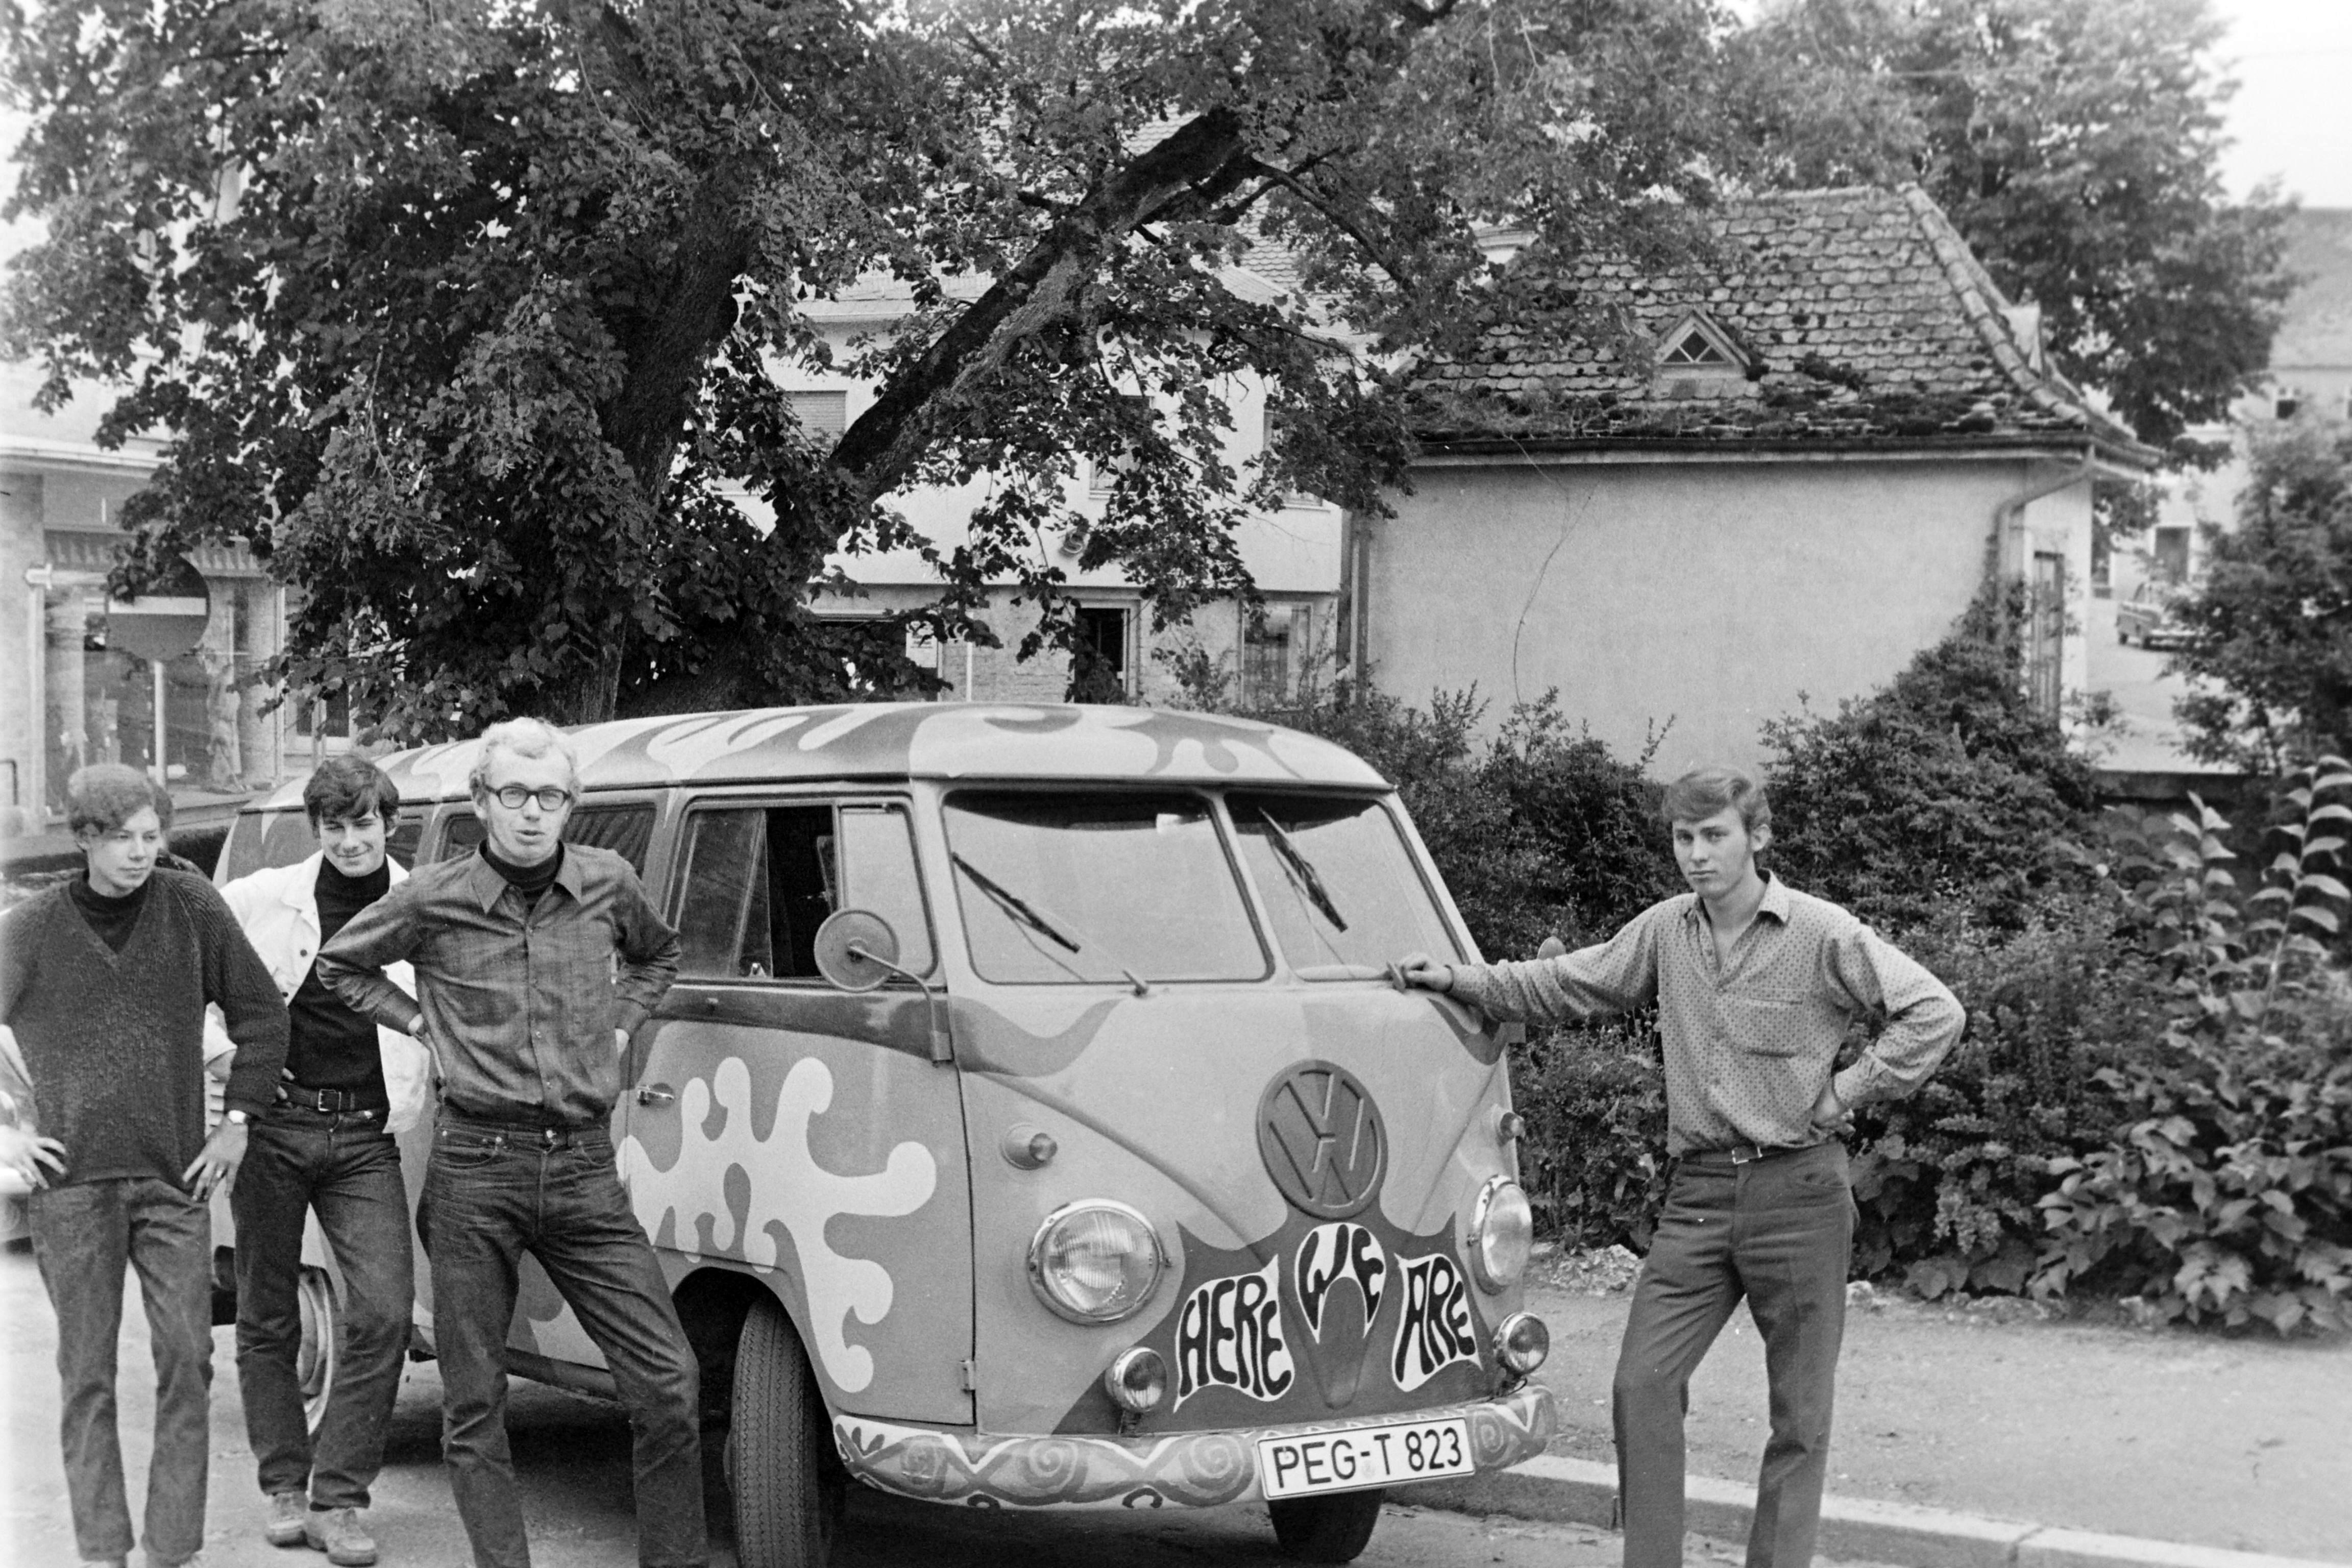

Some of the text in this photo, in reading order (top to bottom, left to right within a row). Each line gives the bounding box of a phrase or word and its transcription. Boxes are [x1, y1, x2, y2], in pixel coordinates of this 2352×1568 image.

[1261, 1065, 1382, 1215] VW
[1179, 1223, 1477, 1398] HERE WE ARE
[1272, 1427, 1462, 1489] PEG-T 823
